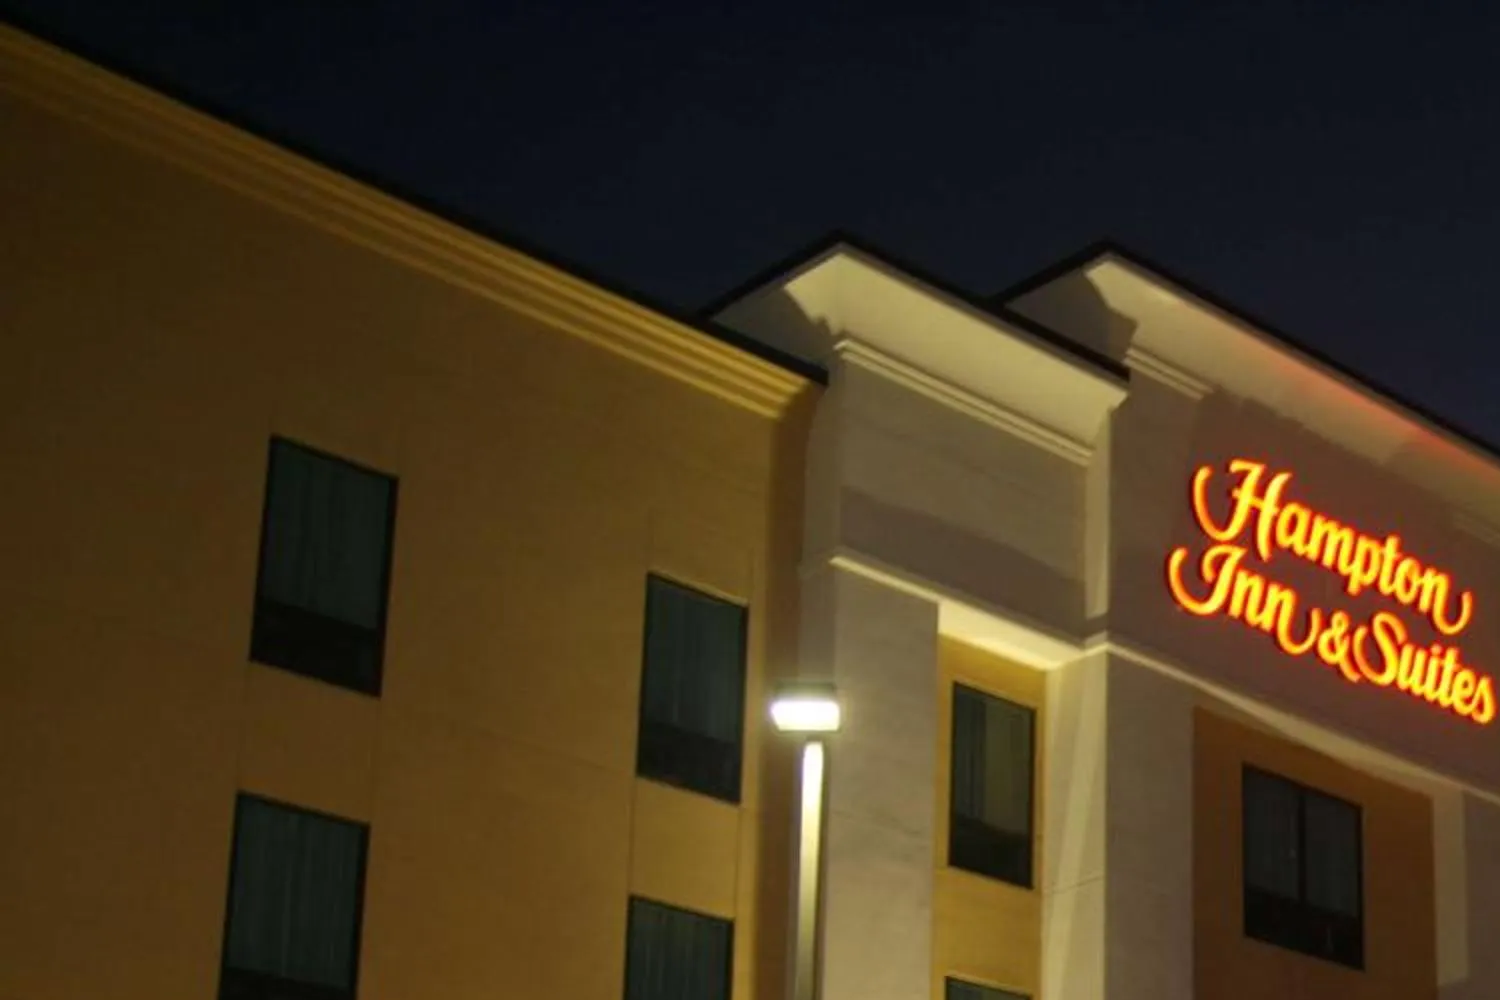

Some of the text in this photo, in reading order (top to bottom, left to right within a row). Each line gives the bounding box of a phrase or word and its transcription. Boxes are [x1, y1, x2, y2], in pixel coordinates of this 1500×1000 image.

[1168, 544, 1497, 724] Inn & Suites
[1191, 458, 1474, 636] Hampton
